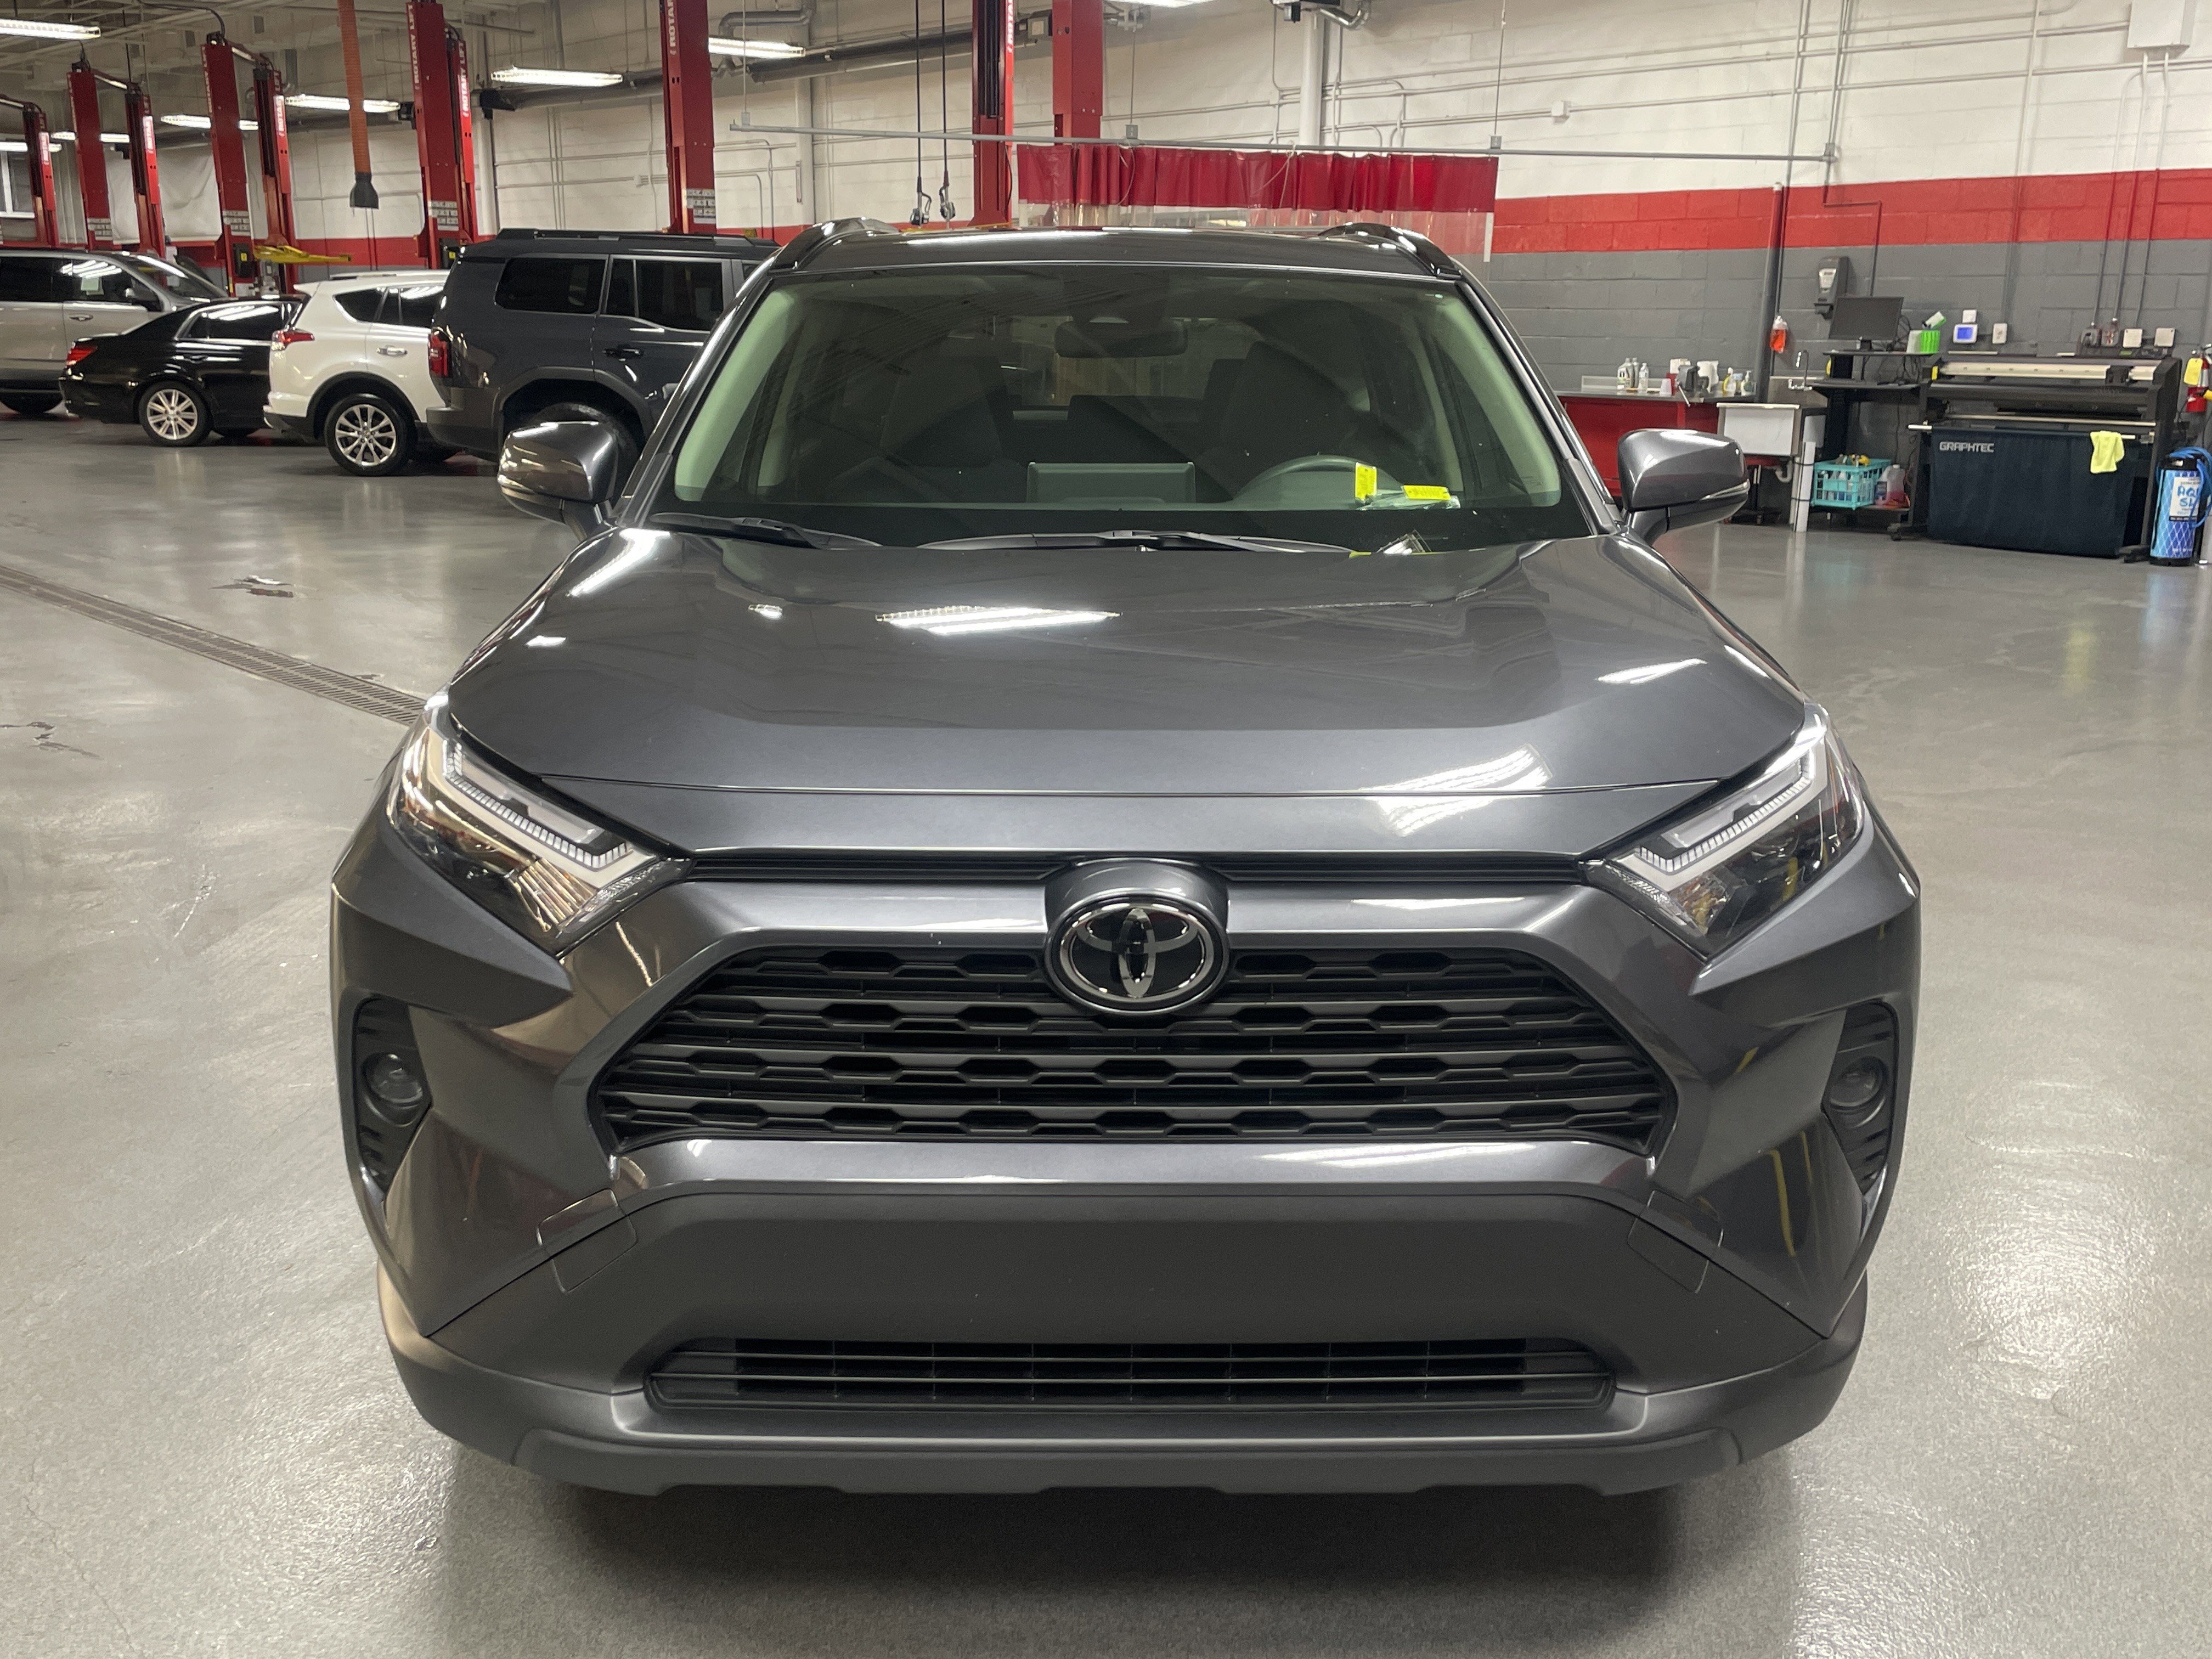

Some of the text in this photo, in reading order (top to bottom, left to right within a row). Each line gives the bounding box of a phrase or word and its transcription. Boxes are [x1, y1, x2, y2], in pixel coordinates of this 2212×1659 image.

[410, 33, 420, 84] ROTARY
[460, 67, 469, 111] ROTARY
[1939, 441, 1995, 453] GRAPHTEC
